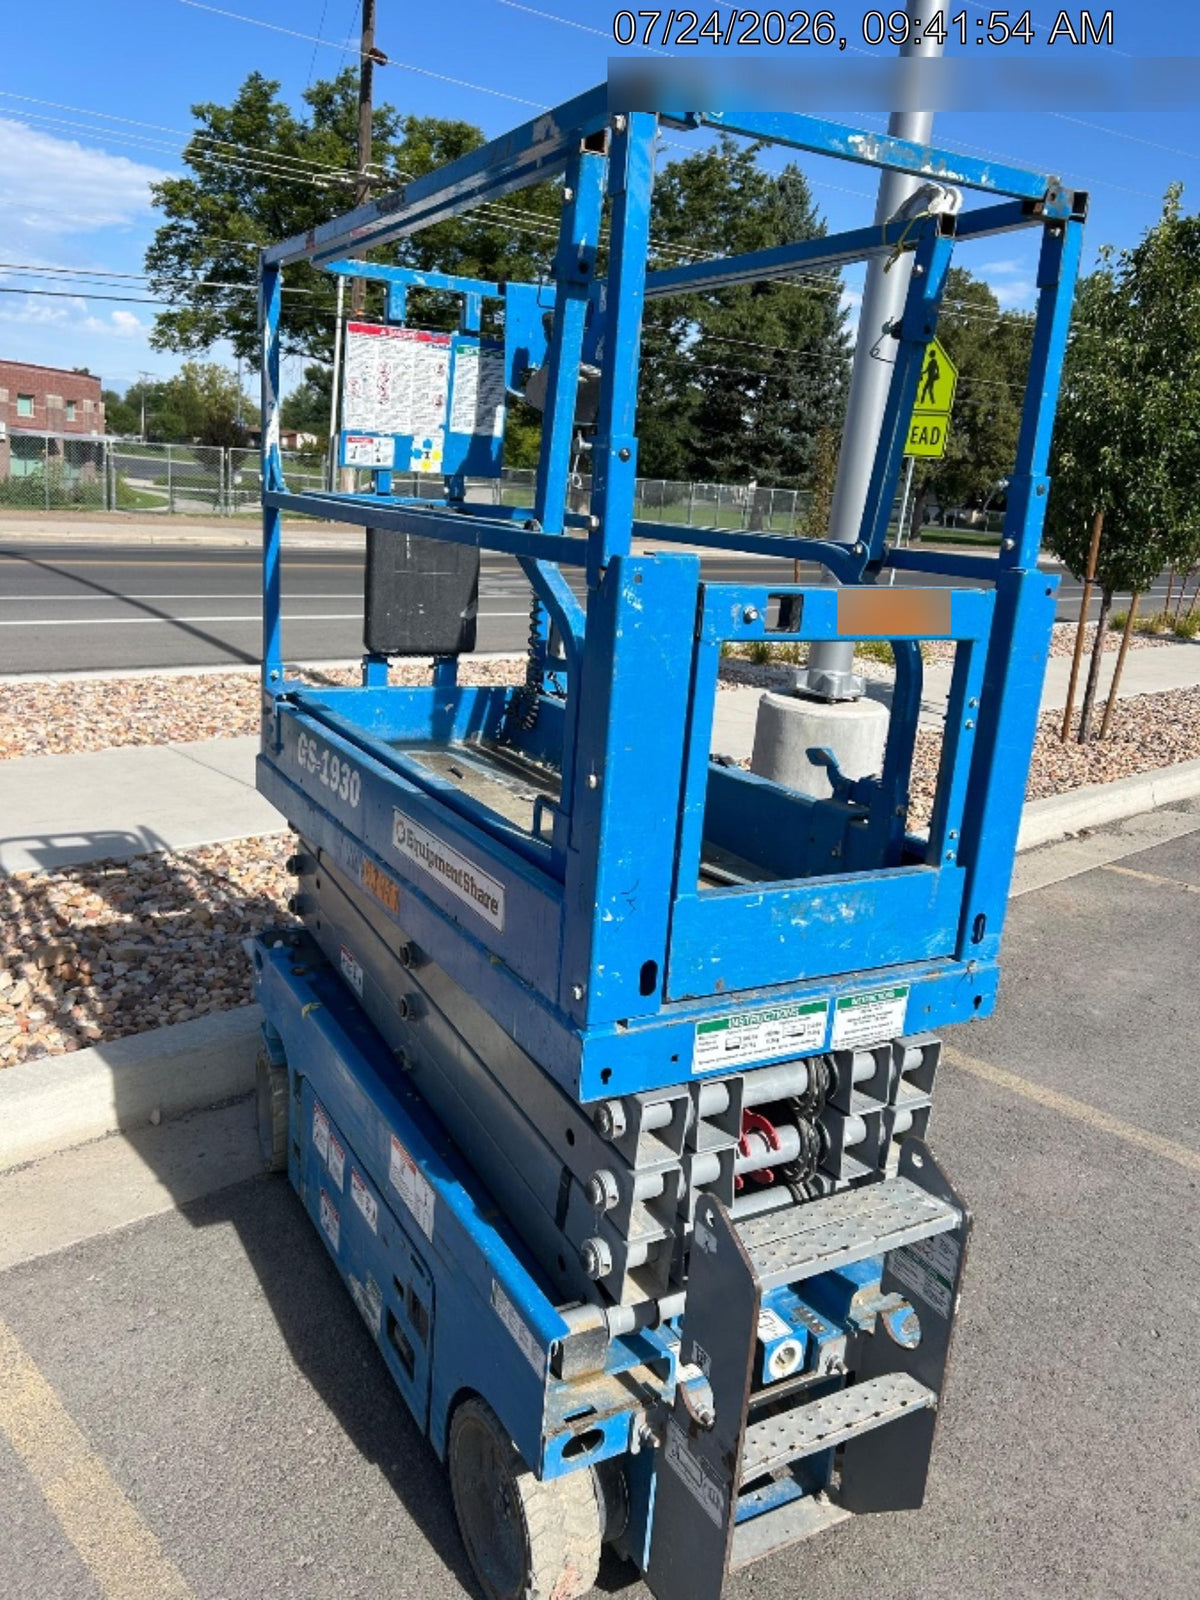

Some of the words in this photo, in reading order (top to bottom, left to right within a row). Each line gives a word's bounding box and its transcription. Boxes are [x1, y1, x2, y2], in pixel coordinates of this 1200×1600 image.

[910, 426, 941, 445] EAD
[297, 732, 361, 808] GS-1930
[405, 828, 500, 916] EquipmentShare
[728, 1006, 799, 1028] INSTRUCTIONS
